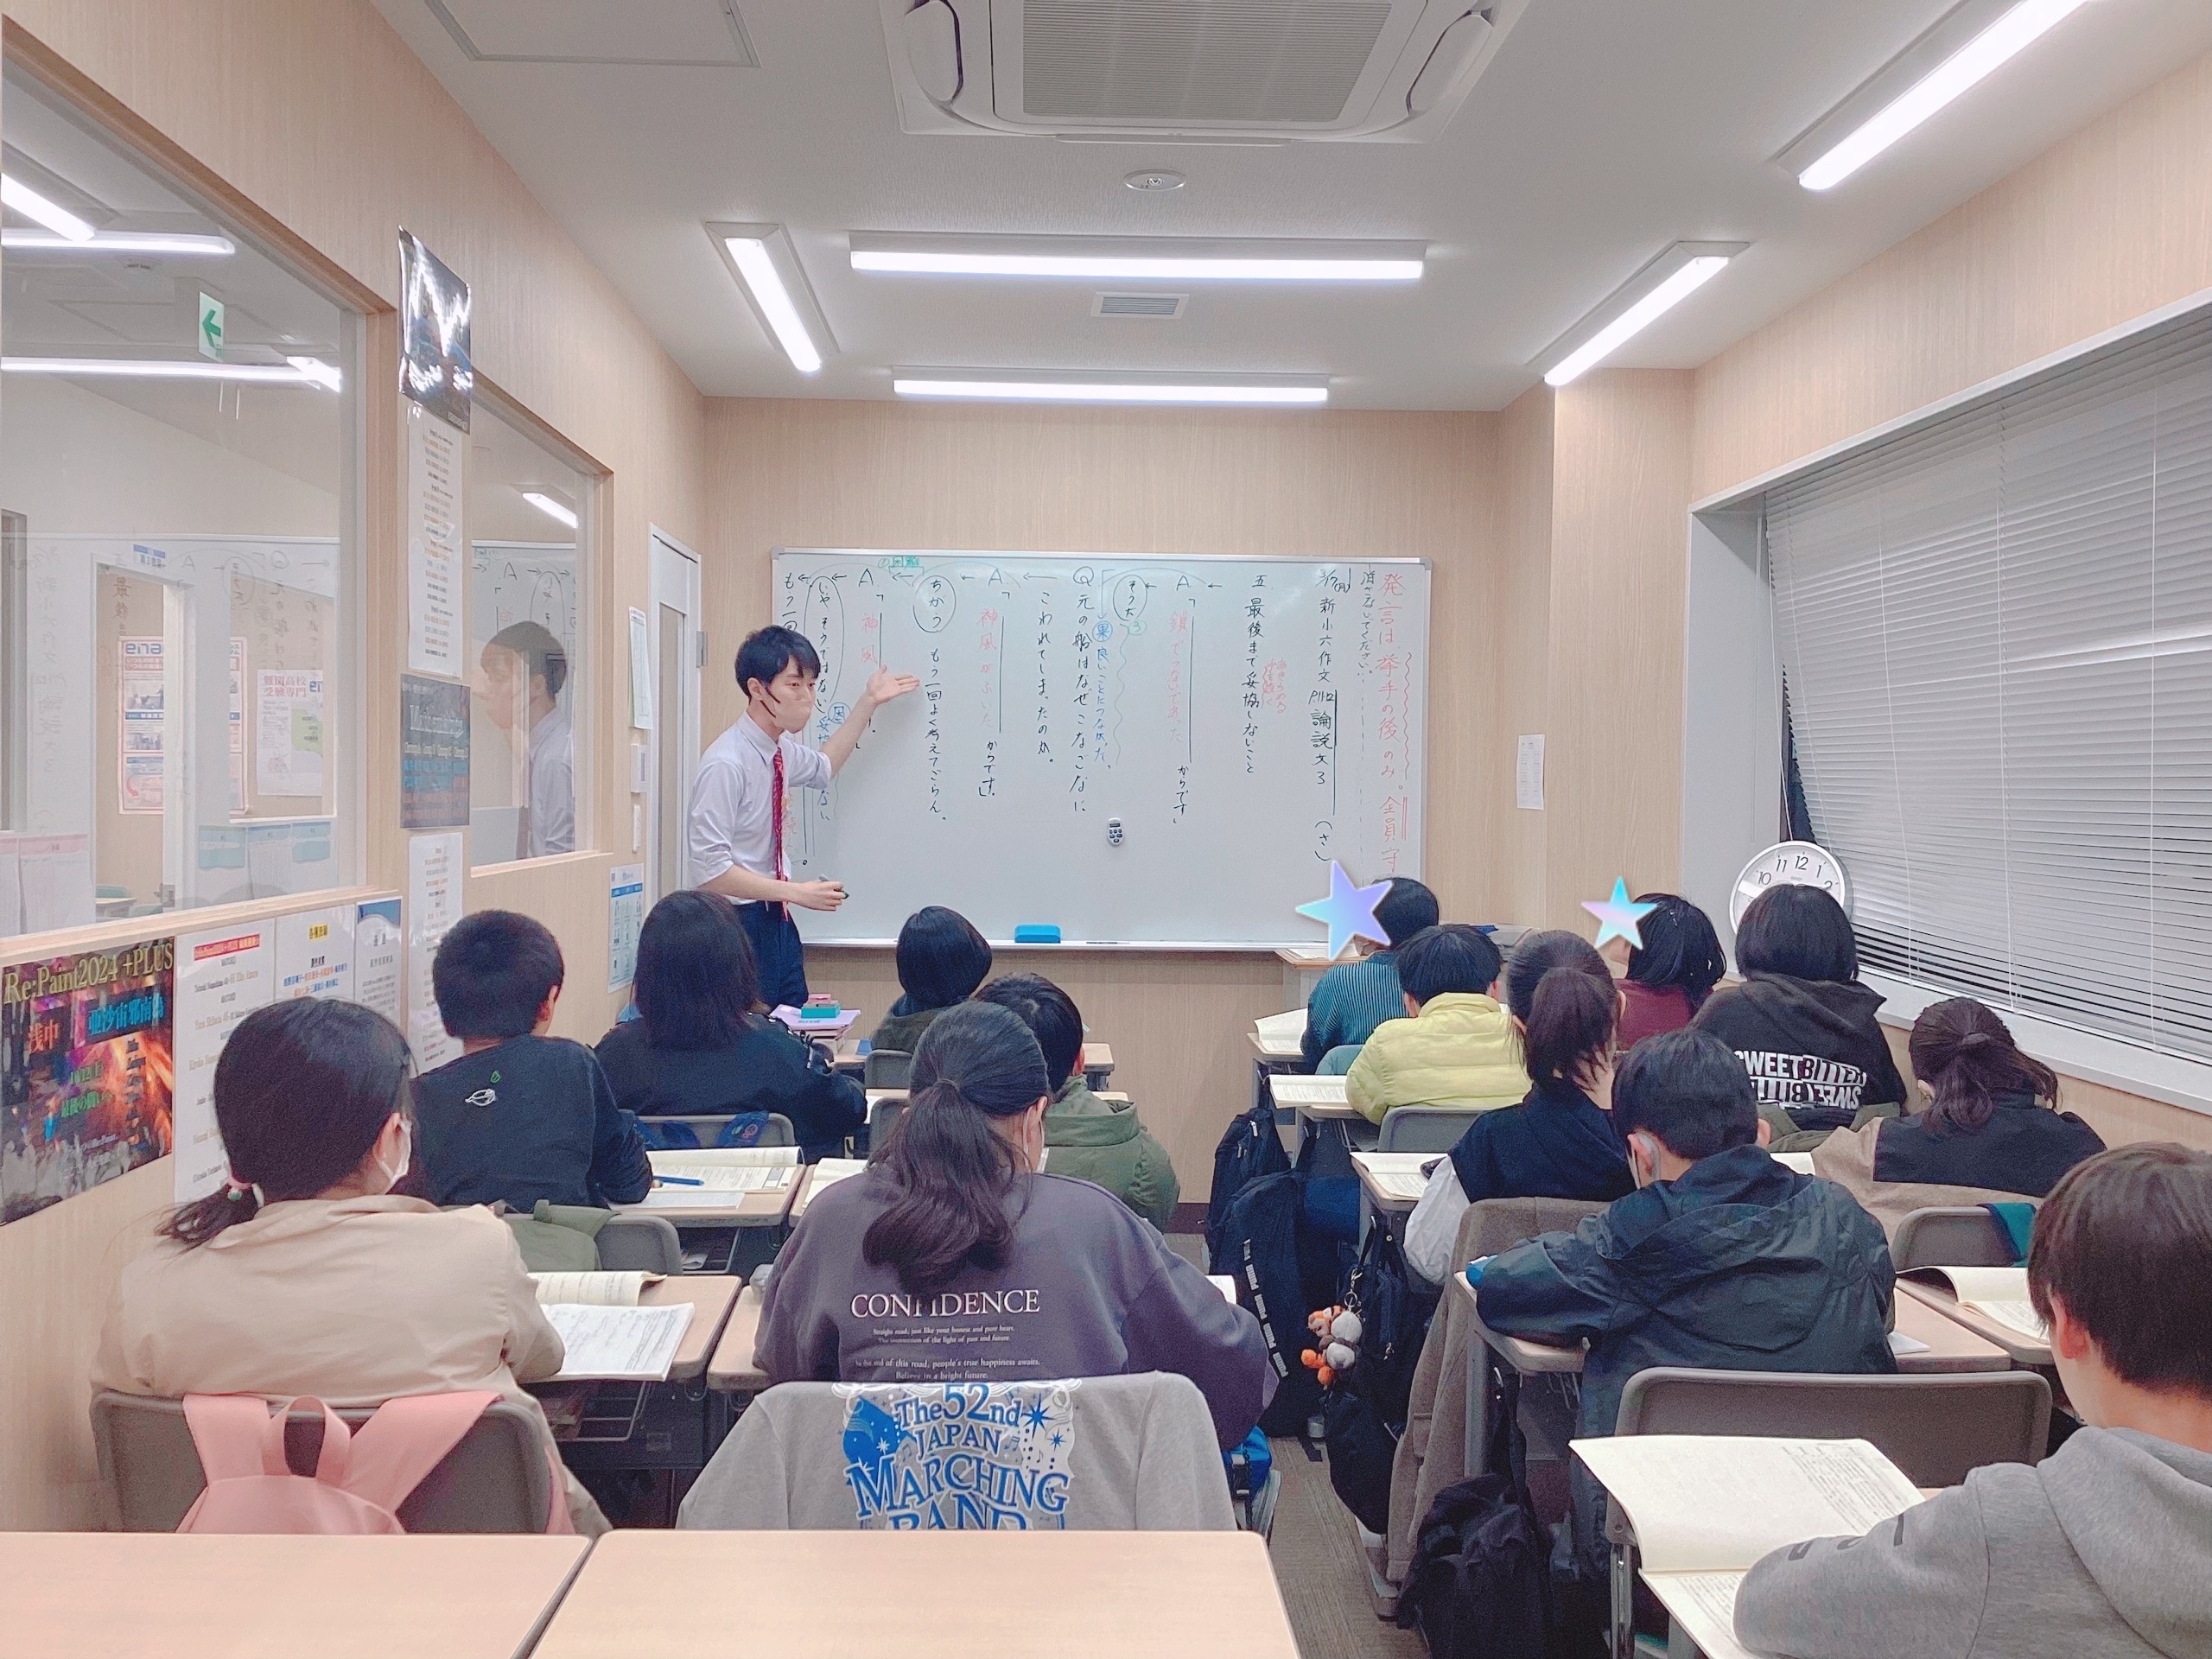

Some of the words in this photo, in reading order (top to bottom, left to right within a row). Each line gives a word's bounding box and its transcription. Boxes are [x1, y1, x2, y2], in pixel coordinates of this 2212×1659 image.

[1777, 858, 1787, 873] 11
[1795, 855, 1808, 870] 12
[1758, 871, 1771, 886] 10
[123, 943, 174, 978] +PLUS
[895, 1357, 909, 1367] this
[931, 1357, 962, 1370] people's
[980, 1357, 1016, 1369] happiness
[895, 1370, 921, 1380] Believe
[940, 1370, 962, 1381] bright
[914, 1424, 1002, 1460] JAPAN
[846, 1453, 1070, 1518] MARCHING
